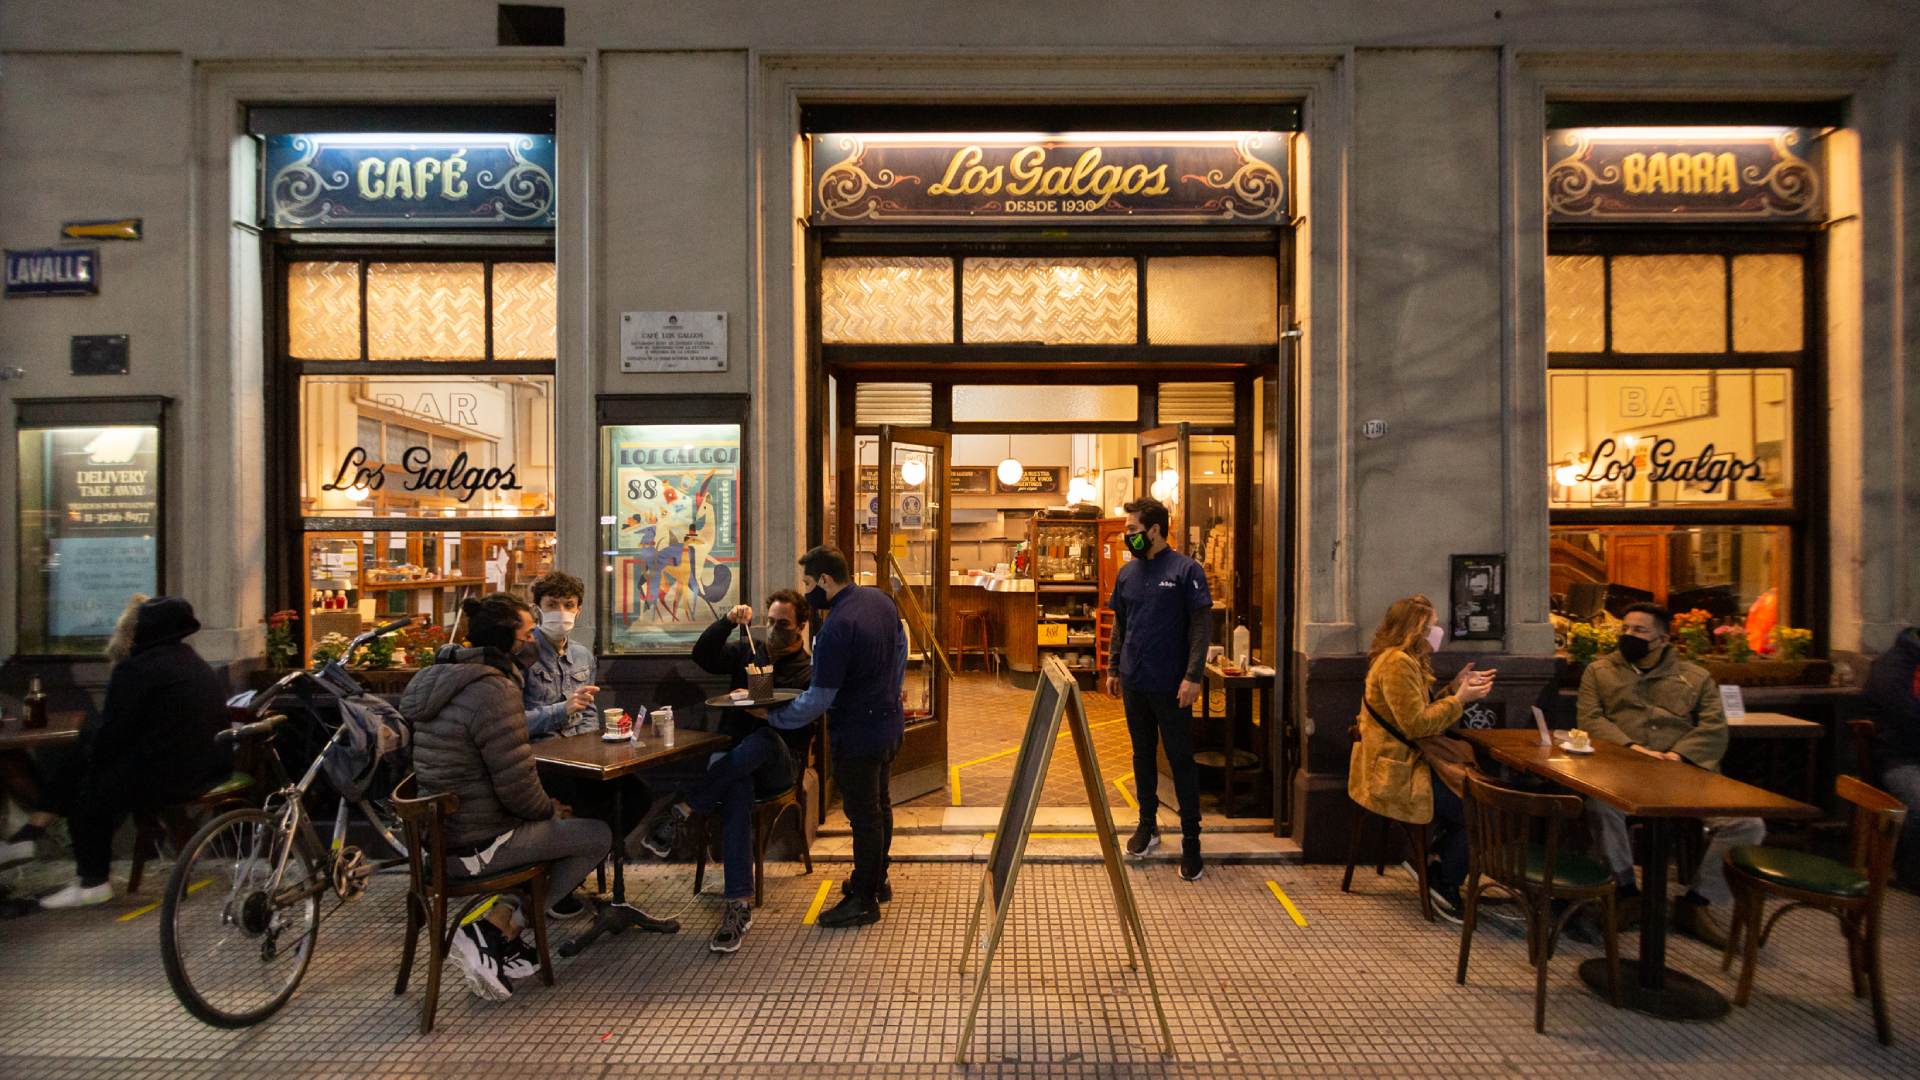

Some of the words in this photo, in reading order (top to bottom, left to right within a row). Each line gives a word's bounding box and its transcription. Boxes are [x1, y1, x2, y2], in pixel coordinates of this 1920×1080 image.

[358, 149, 468, 200] CAFÉ
[927, 145, 1004, 197] Los
[1005, 145, 1169, 210] Galgos
[1623, 152, 1740, 194] BARRA
[1005, 201, 1057, 213] DESDE
[1062, 201, 1095, 212] 1930
[8, 256, 90, 284] LAVALLE
[376, 392, 479, 425] BAR
[1365, 422, 1386, 434] 1791
[620, 449, 658, 465] LOS
[1575, 438, 1636, 482] Los
[1647, 438, 1766, 494] Galgos
[76, 470, 147, 483] DELIVERY
[321, 446, 385, 491] Los
[402, 446, 523, 503] Galgos
[78, 485, 111, 496] TAKE
[112, 485, 145, 496] AWAY
[627, 479, 657, 499] 88
